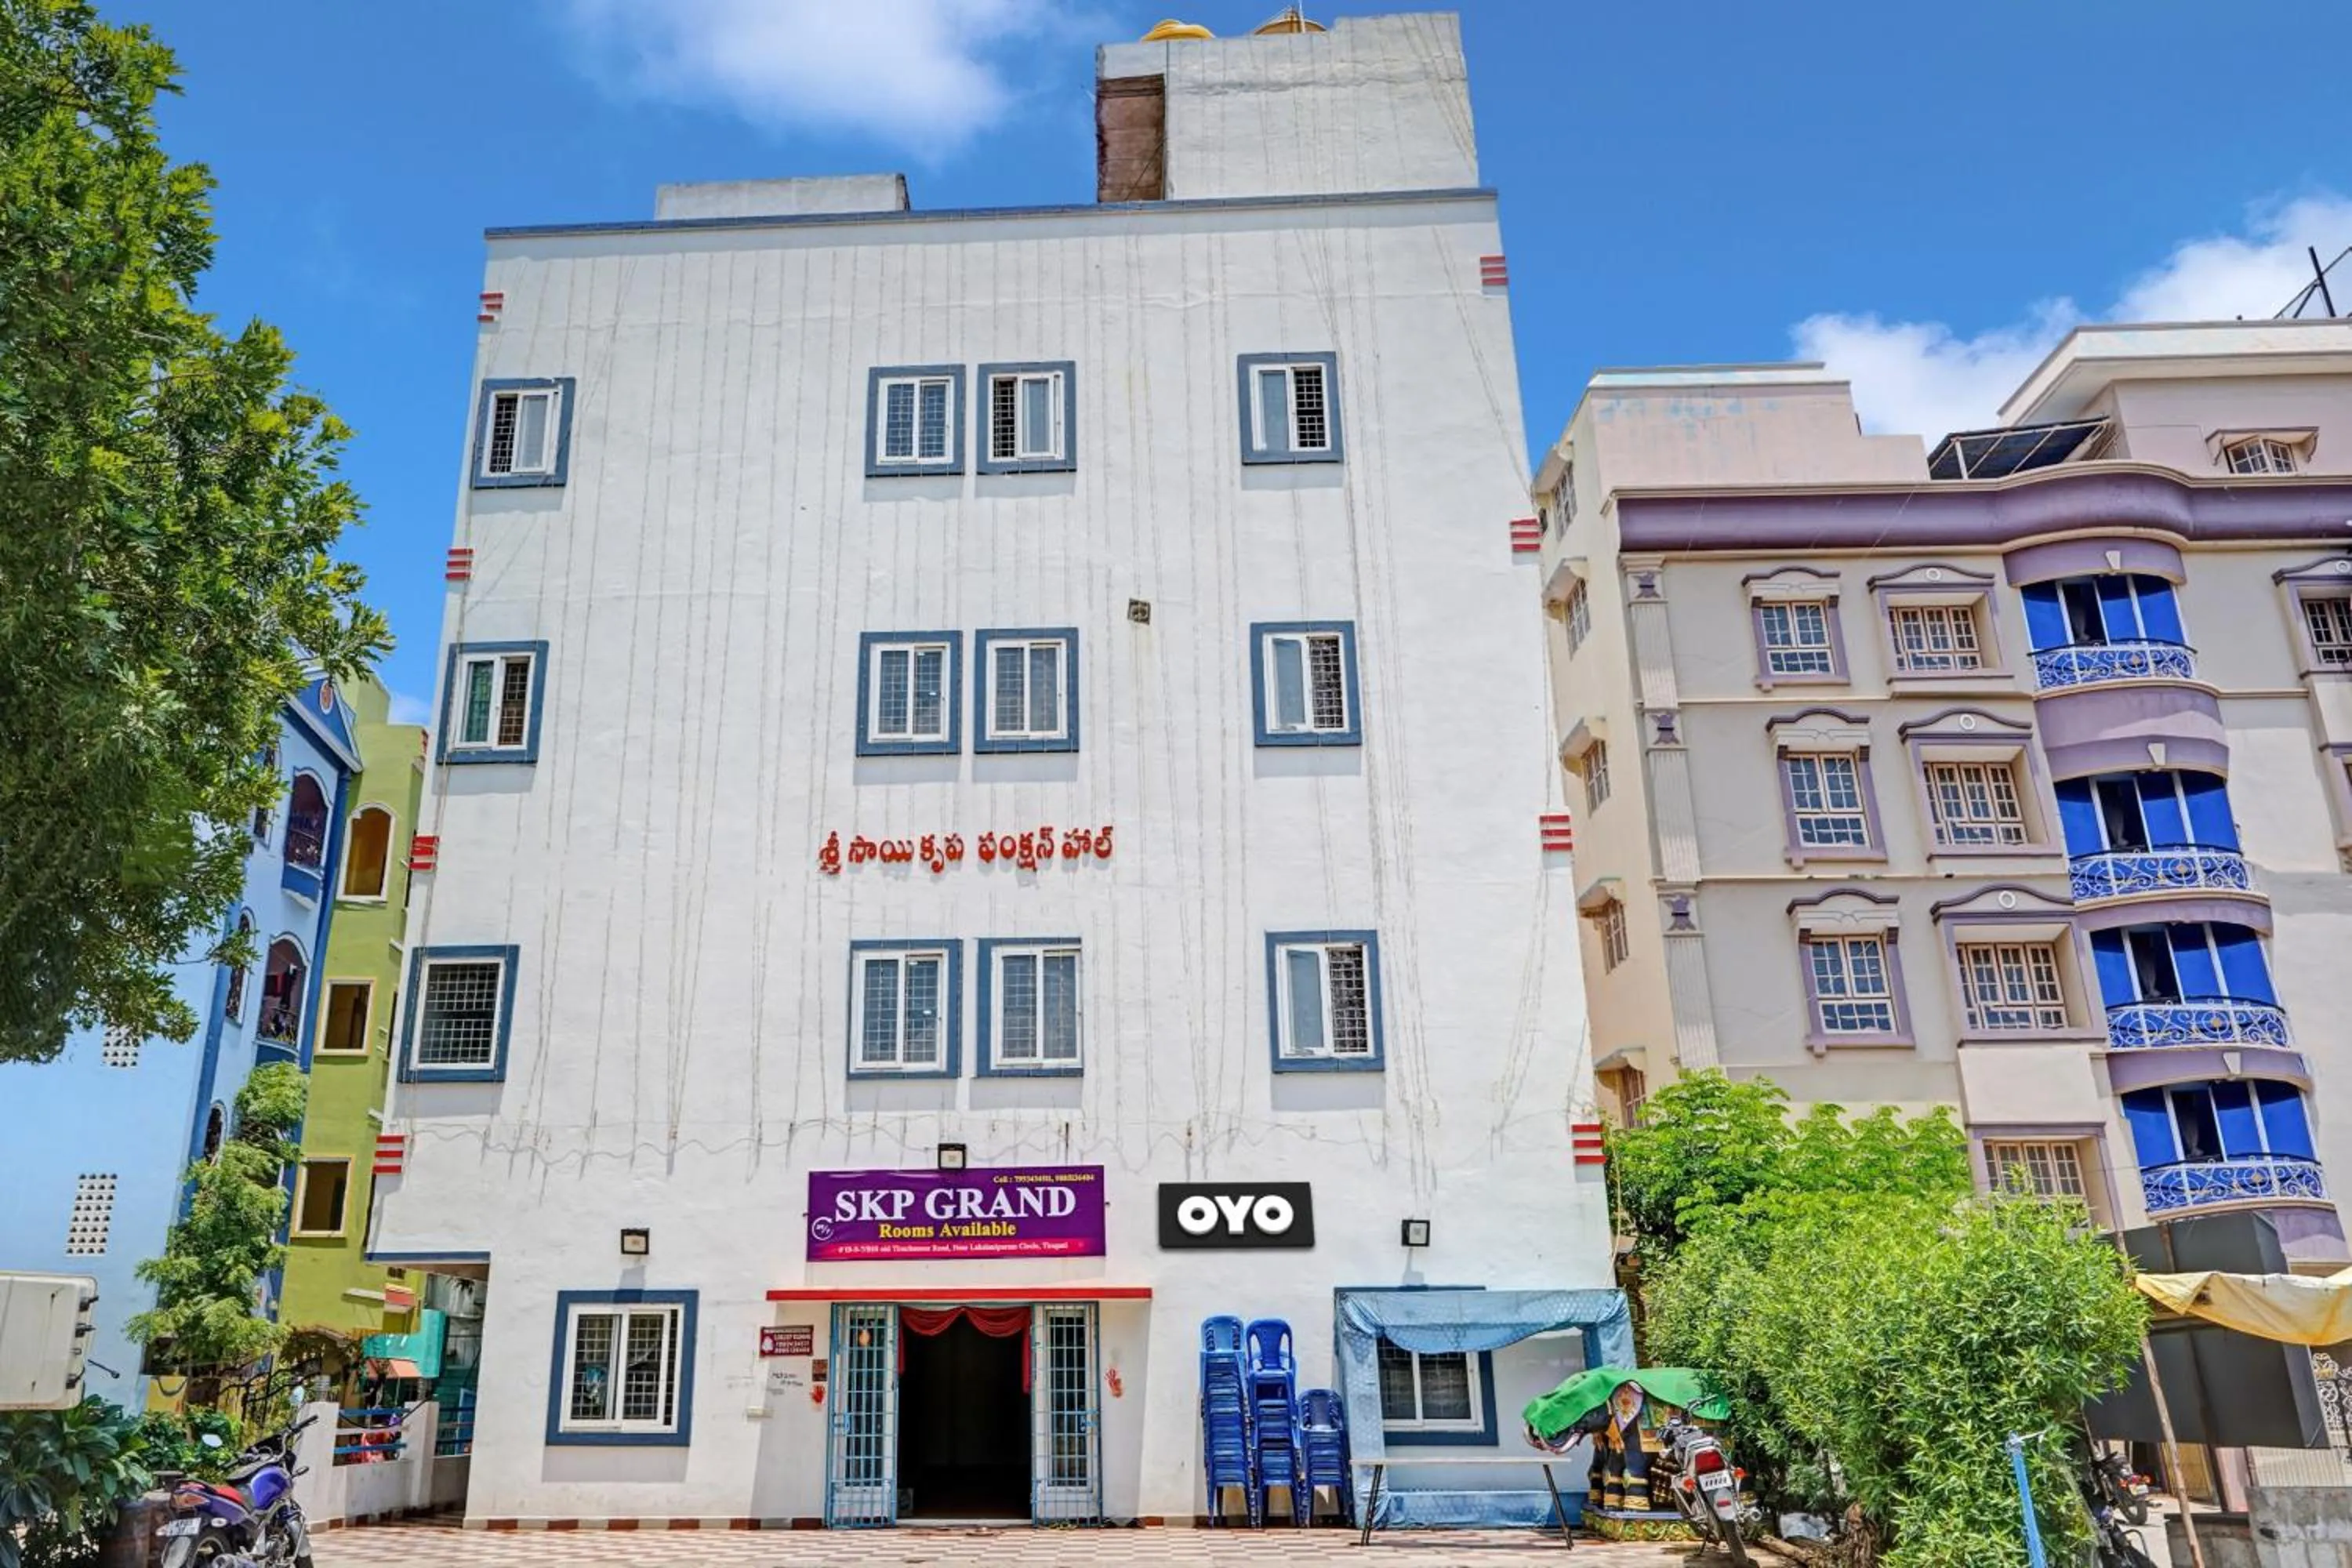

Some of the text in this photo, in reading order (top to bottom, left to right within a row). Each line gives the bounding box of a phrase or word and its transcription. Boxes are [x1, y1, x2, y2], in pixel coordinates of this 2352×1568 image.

[834, 1185, 1077, 1223] SKP GRAND
[1178, 1194, 1294, 1236] OYO
[878, 1220, 1017, 1239] Rooms Available
